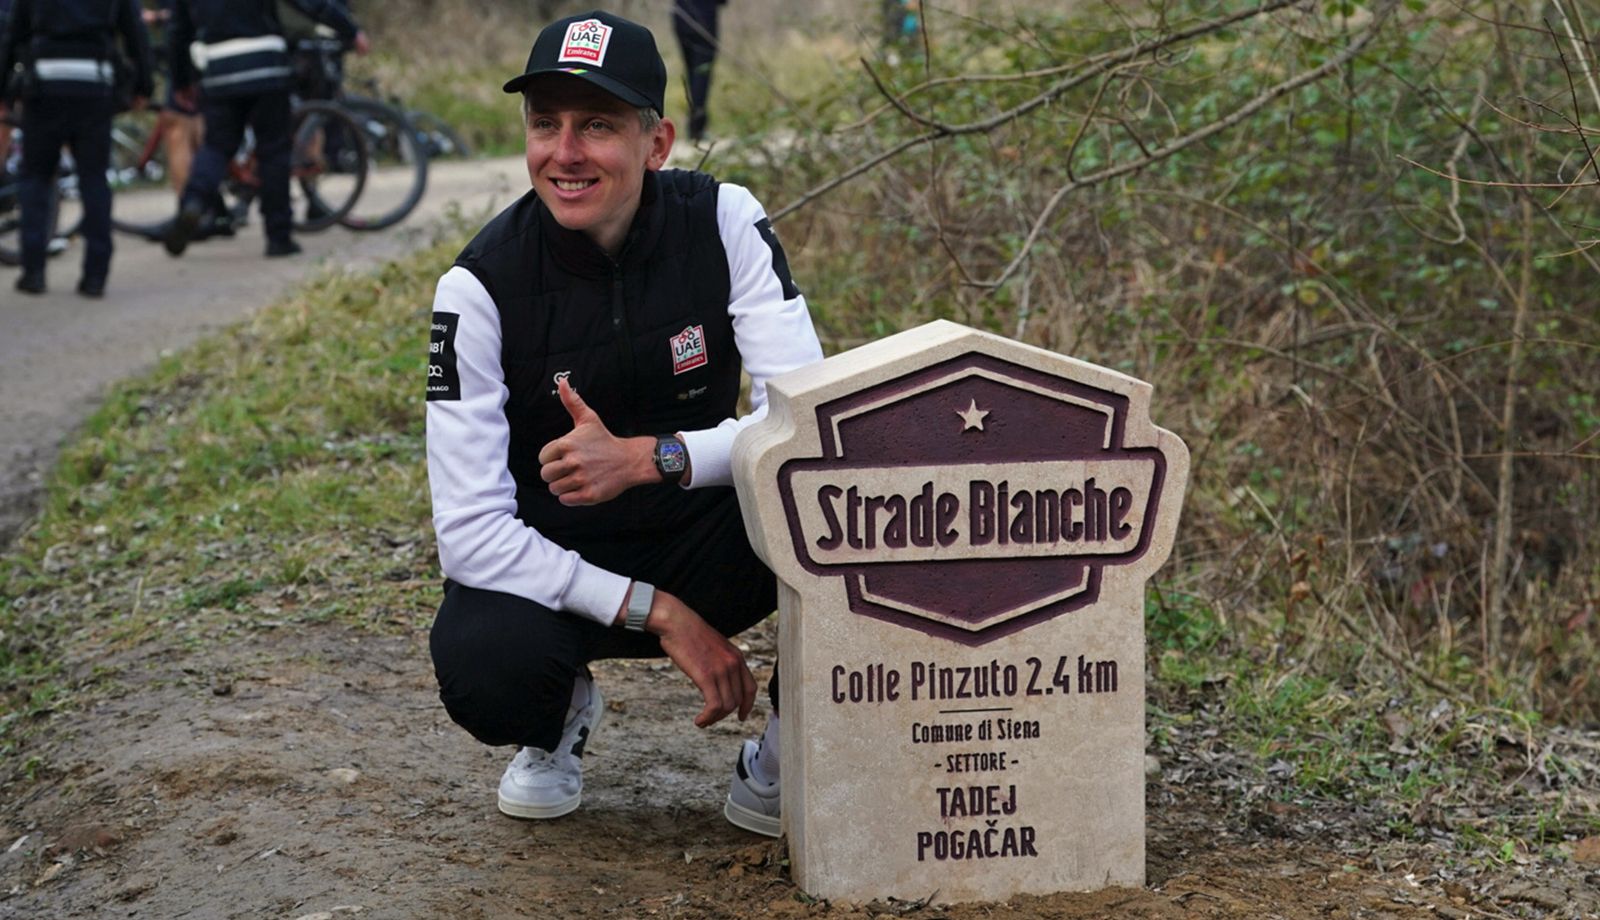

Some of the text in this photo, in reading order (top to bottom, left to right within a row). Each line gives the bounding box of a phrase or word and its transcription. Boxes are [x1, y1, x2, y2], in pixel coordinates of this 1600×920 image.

[570, 41, 599, 49] TEAM
[571, 32, 602, 44] UAE
[567, 49, 597, 57] Emirates
[675, 338, 701, 356] UAE
[816, 477, 1133, 550] Strade Bianche
[831, 654, 1118, 704] Colle Pinzuto 2.4 km
[912, 718, 1041, 744] Comune di Siena
[946, 752, 1007, 773] SETTORE
[936, 785, 1017, 817] TADEJ
[917, 820, 1038, 861] POGAČAR
